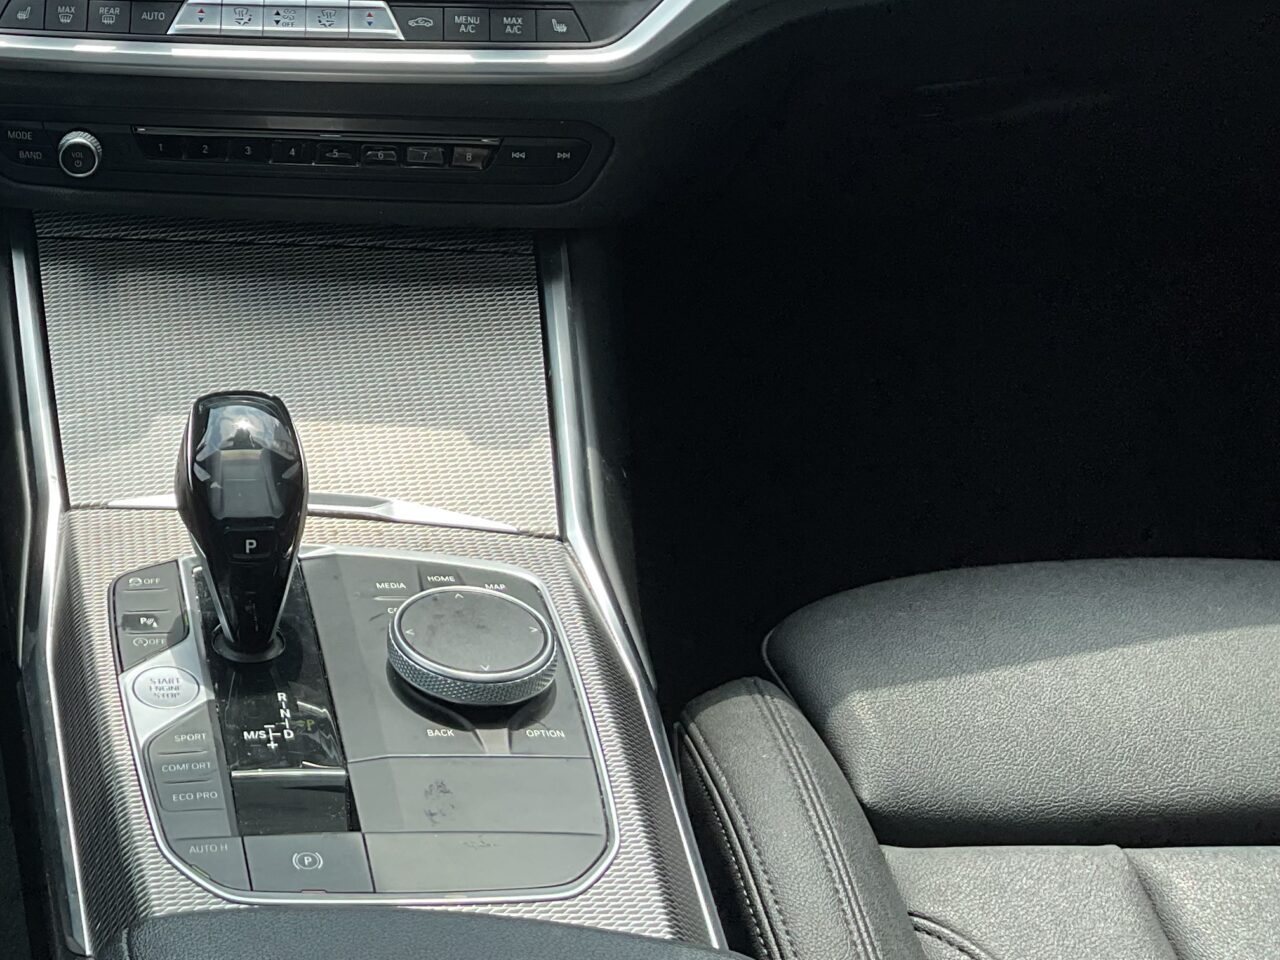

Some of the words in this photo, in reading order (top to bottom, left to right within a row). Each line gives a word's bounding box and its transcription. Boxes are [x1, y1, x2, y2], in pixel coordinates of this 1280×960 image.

[57, 5, 76, 14] MAX
[99, 6, 120, 15] REAR
[141, 11, 166, 21] AUTO
[454, 14, 481, 25] MENU
[502, 16, 524, 26] MAX
[458, 24, 477, 33] A/C
[505, 25, 523, 34] A/C
[7, 130, 33, 140] MODE
[158, 143, 164, 152] 1
[202, 145, 209, 154] 2
[245, 146, 252, 155] 3
[289, 147, 296, 157] 4
[19, 150, 42, 160] BAND
[71, 151, 85, 159] VOL
[332, 149, 339, 158] 5
[377, 151, 384, 160] 6
[422, 152, 429, 161] 7
[465, 153, 472, 162] 8
[245, 539, 257, 553] P
[143, 577, 161, 585] OFF
[427, 575, 456, 583] HOME
[376, 581, 407, 590] MEDIA
[485, 583, 506, 591] MAP
[387, 607, 398, 615] CO
[277, 692, 287, 702] R
[280, 708, 291, 718] N
[306, 720, 315, 731] P
[174, 732, 207, 742] SPORT
[243, 730, 267, 740] M/S
[283, 729, 295, 740] D
[427, 729, 455, 737] BACK
[526, 730, 566, 738] OPTION
[161, 761, 212, 773] COMFORT
[172, 792, 192, 802] ECO
[194, 790, 218, 801] PRO
[189, 843, 217, 855] AUTO
[220, 843, 229, 853] H
